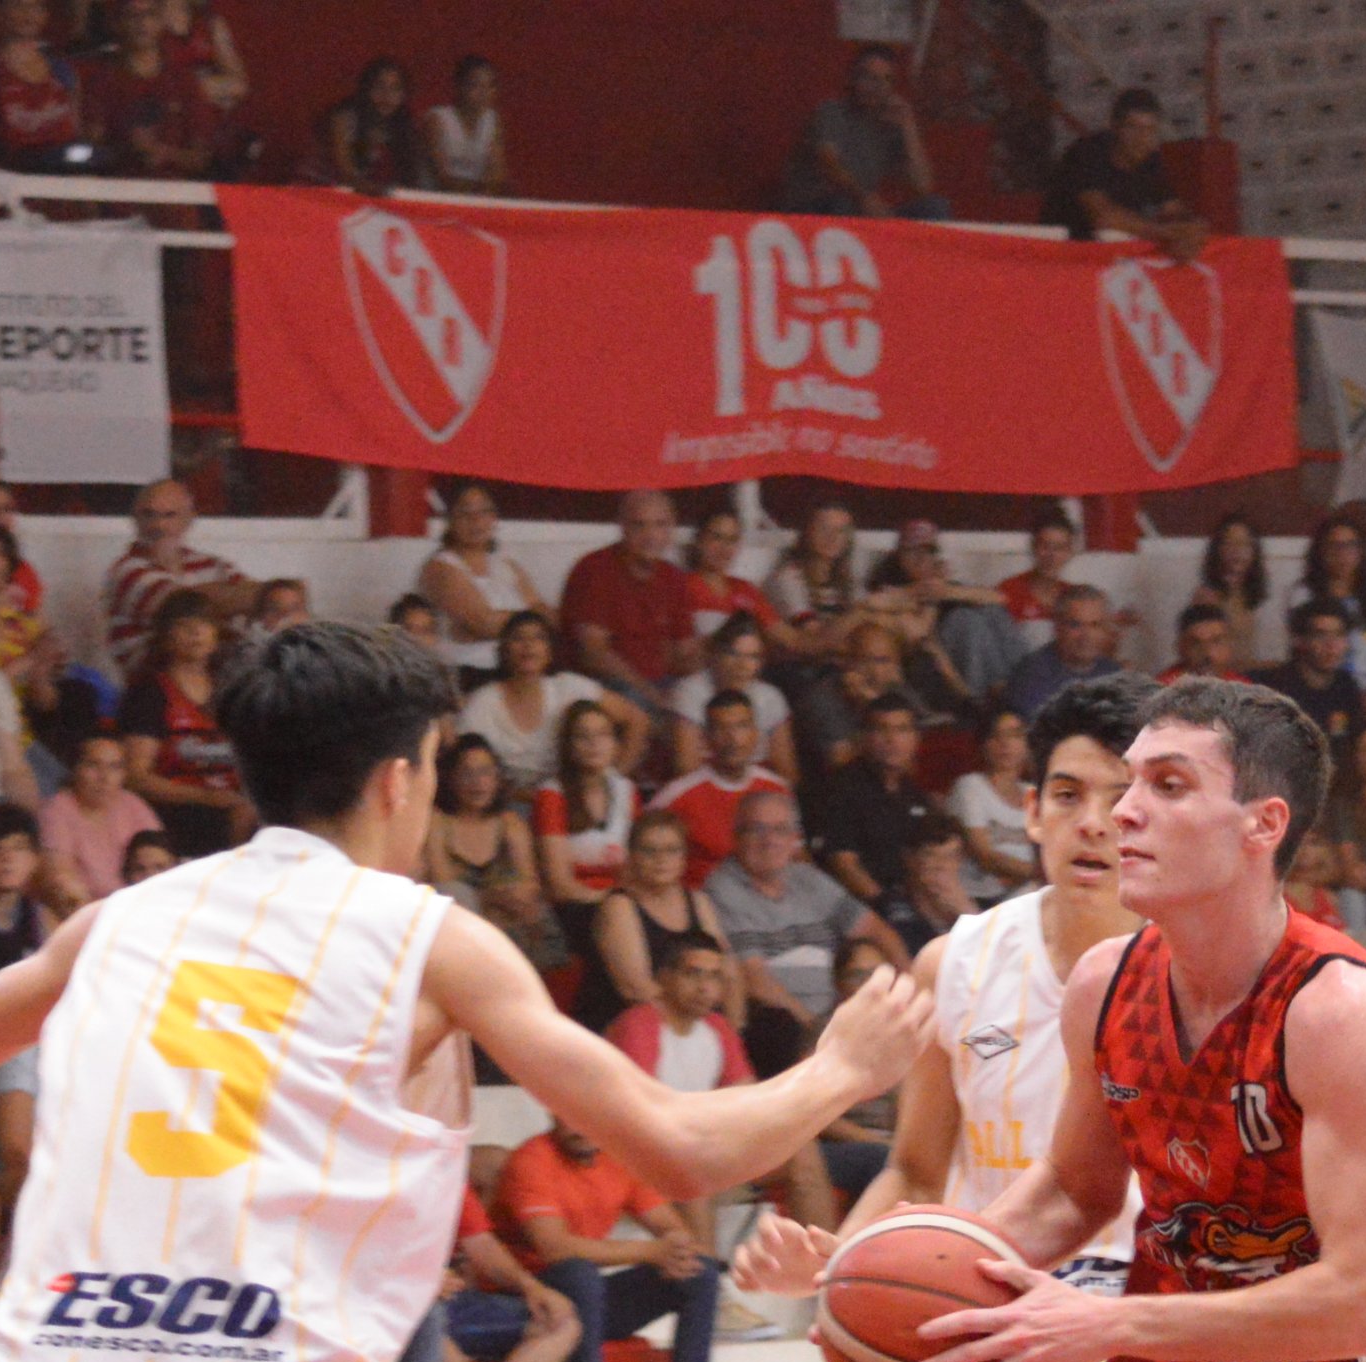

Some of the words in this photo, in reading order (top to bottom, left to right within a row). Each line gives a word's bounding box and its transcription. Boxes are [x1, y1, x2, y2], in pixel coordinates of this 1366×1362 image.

[694, 221, 883, 415] 100
[125, 960, 301, 1178] 5
[1230, 1083, 1283, 1155] 10
[44, 1271, 281, 1339] ESCO
